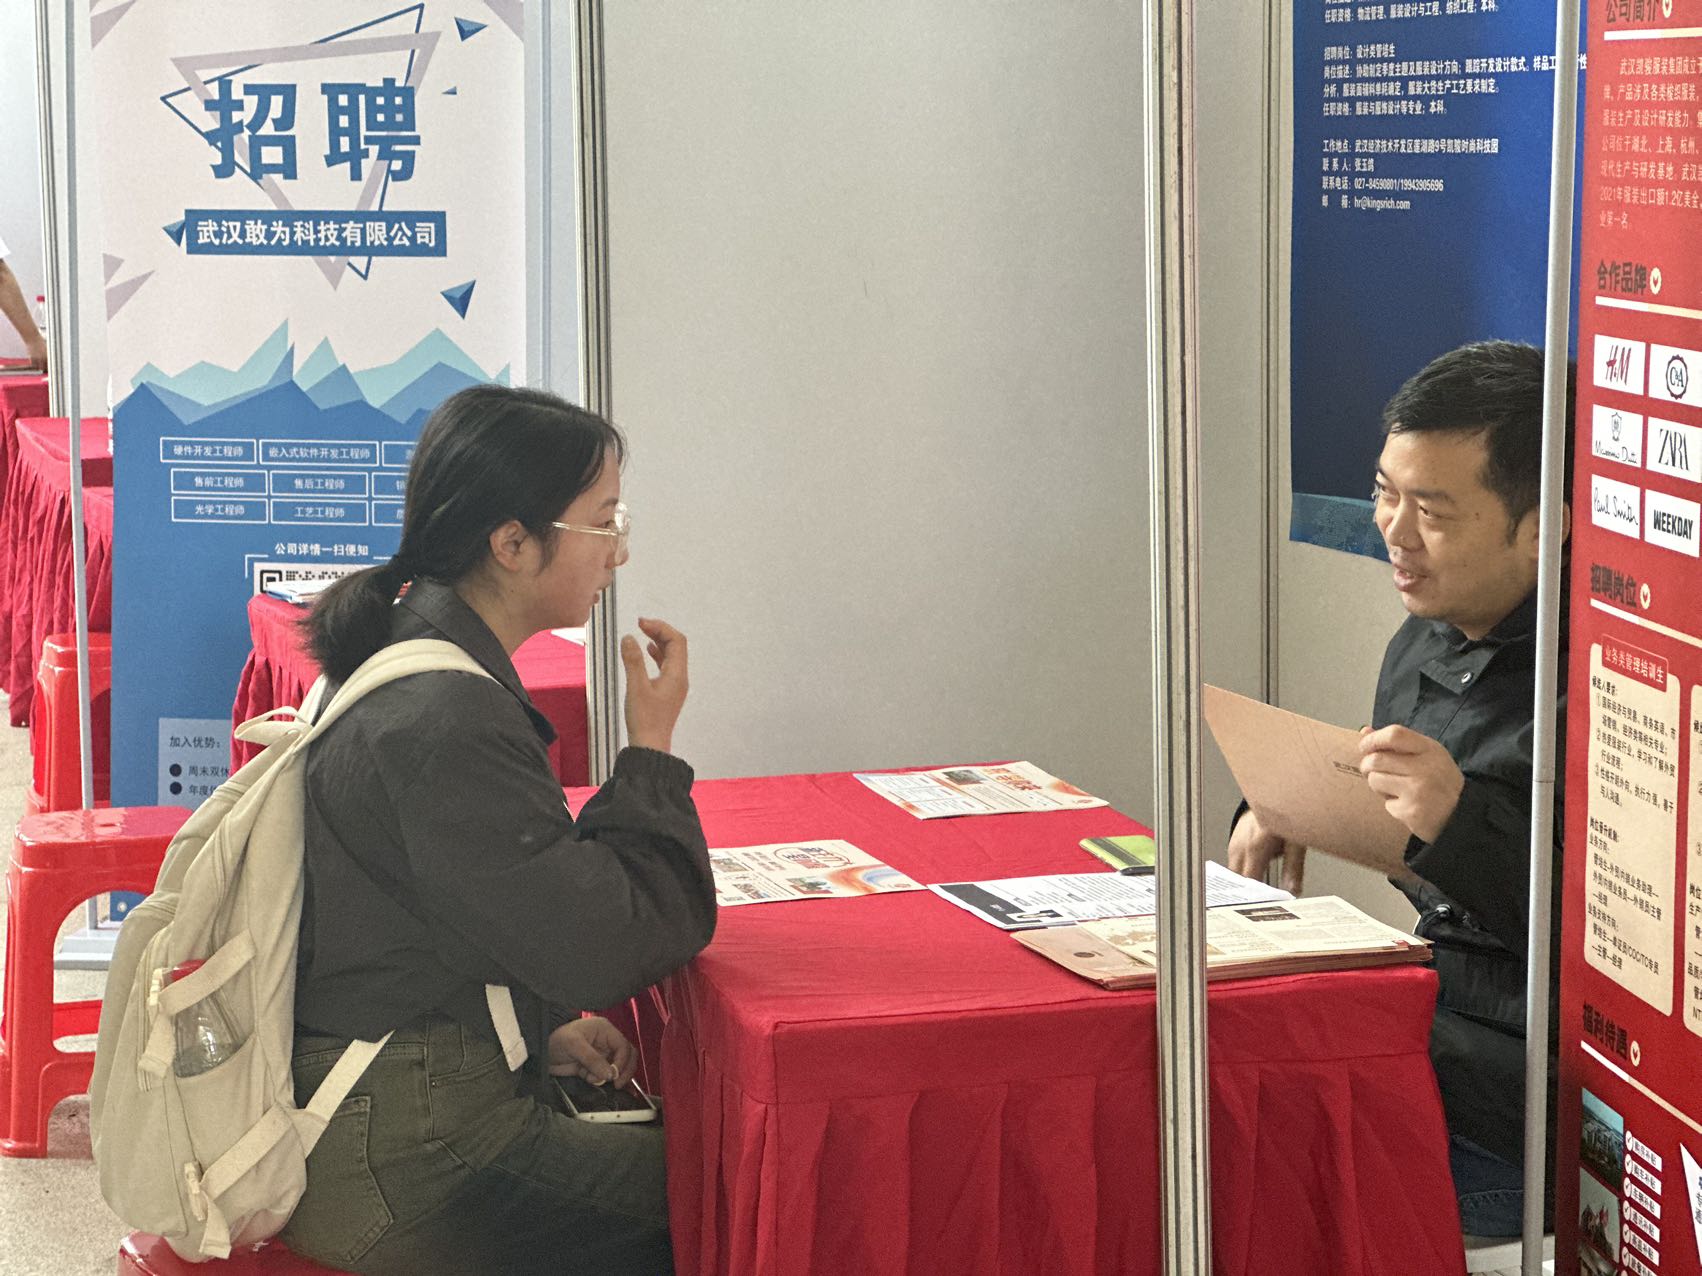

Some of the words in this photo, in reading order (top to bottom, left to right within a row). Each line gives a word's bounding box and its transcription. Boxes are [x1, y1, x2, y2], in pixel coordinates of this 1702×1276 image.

[203, 78, 421, 181] 招聘
[197, 219, 436, 247] 武汉敢为科技有限公司
[1597, 259, 1647, 295] 合作品牌
[173, 445, 244, 457] 硬件开发工程师
[269, 447, 371, 459] 嵌入式软件开发工程师
[1658, 428, 1690, 471] ZARA
[194, 476, 244, 488] 售前工程师
[294, 478, 345, 490] 售后工程师
[195, 504, 245, 516] 光学工程师
[294, 506, 345, 518] 工艺工程师
[1653, 509, 1693, 541] WEEKDAY
[275, 543, 369, 557] 公司详情一扫便知
